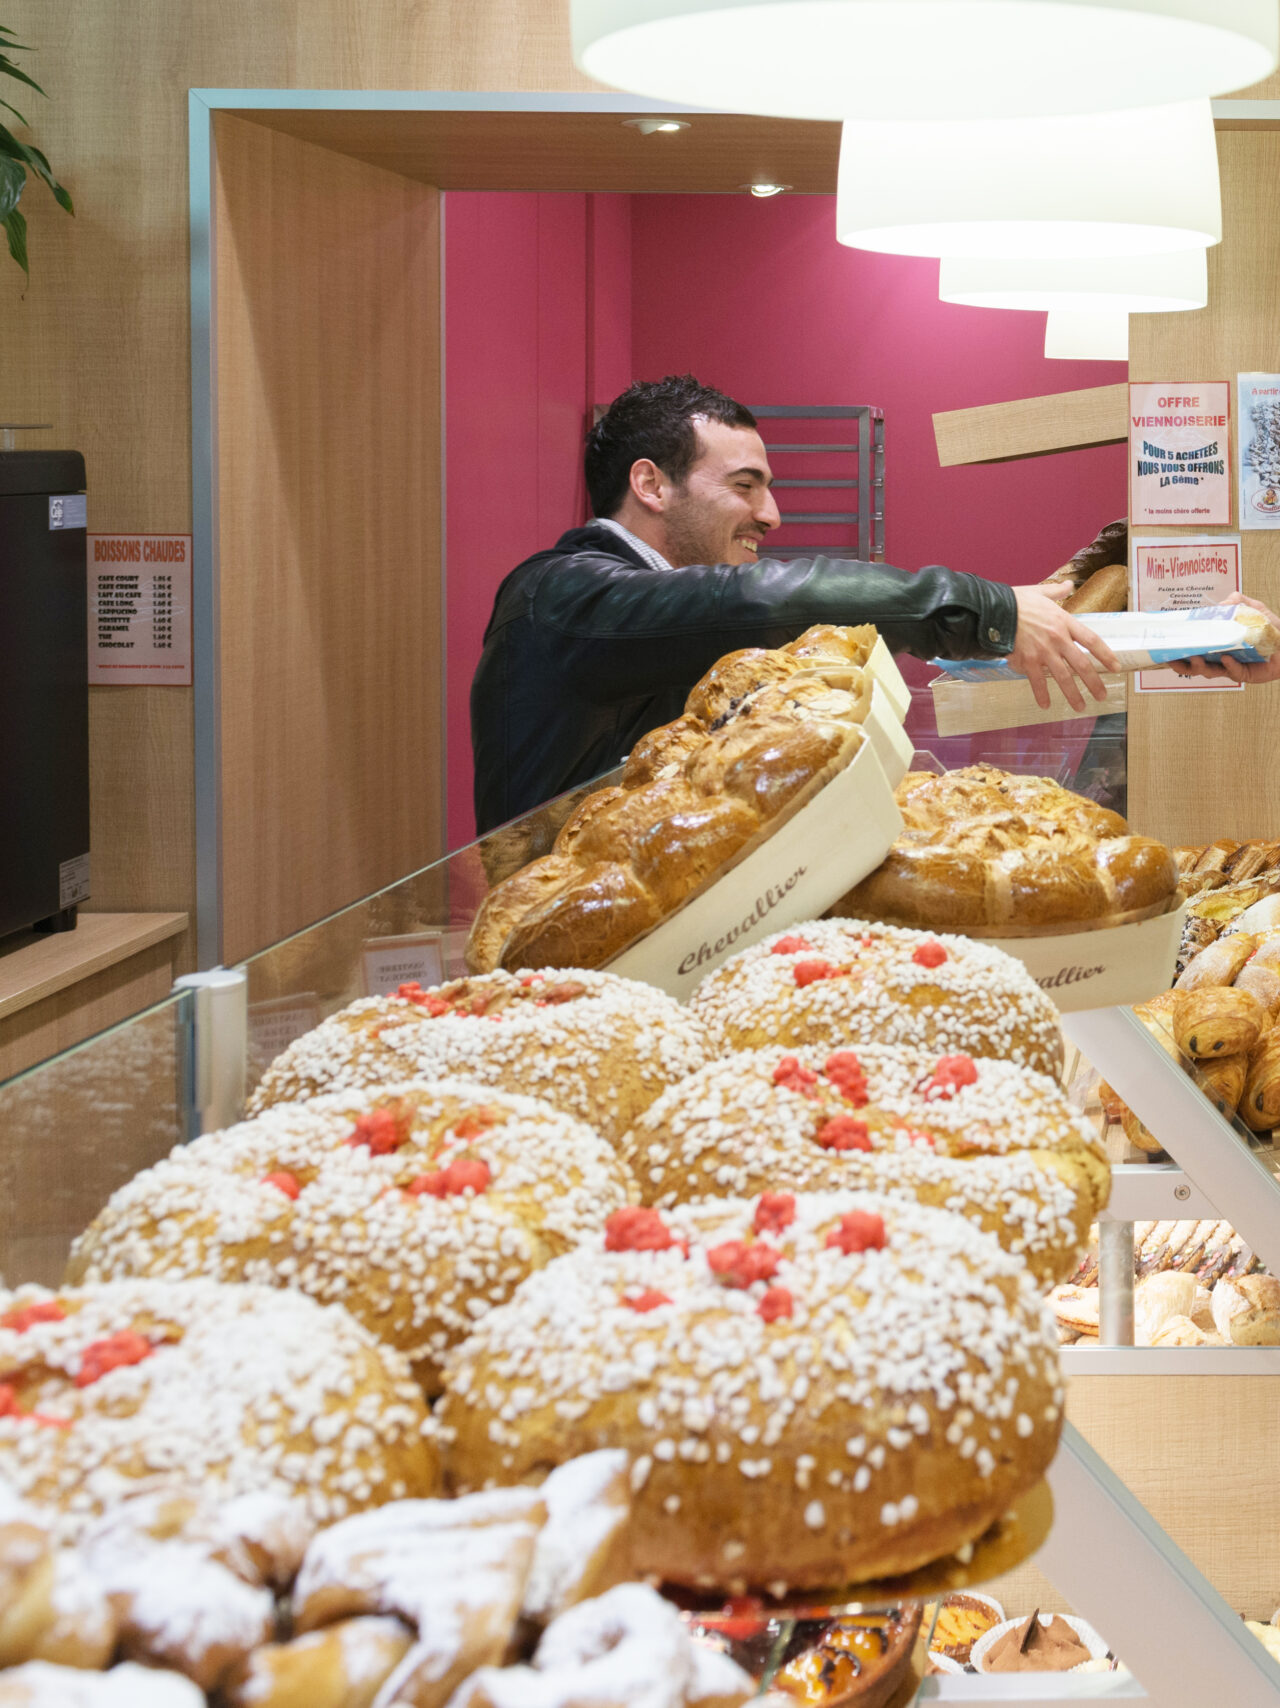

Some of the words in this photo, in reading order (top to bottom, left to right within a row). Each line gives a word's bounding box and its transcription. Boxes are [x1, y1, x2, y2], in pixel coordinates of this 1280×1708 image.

[1260, 387, 1278, 396] partir
[1157, 396, 1200, 408] OFFRE
[1132, 415, 1226, 427] VIENNOISERIE
[1143, 440, 1166, 459] POUR
[1167, 451, 1174, 460] 5
[1175, 441, 1218, 460] ACHETEES
[1137, 460, 1160, 477] NOUS
[1160, 463, 1185, 473] VOUS
[1187, 460, 1225, 475] OFFRONS
[1160, 476, 1170, 488] LA
[94, 540, 141, 562] BOISSONS
[143, 541, 186, 562] CHAUDES
[1146, 552, 1228, 579] Mini-Viennoiseries
[677, 866, 807, 976] Chevallier
[1035, 965, 1106, 989] allier
